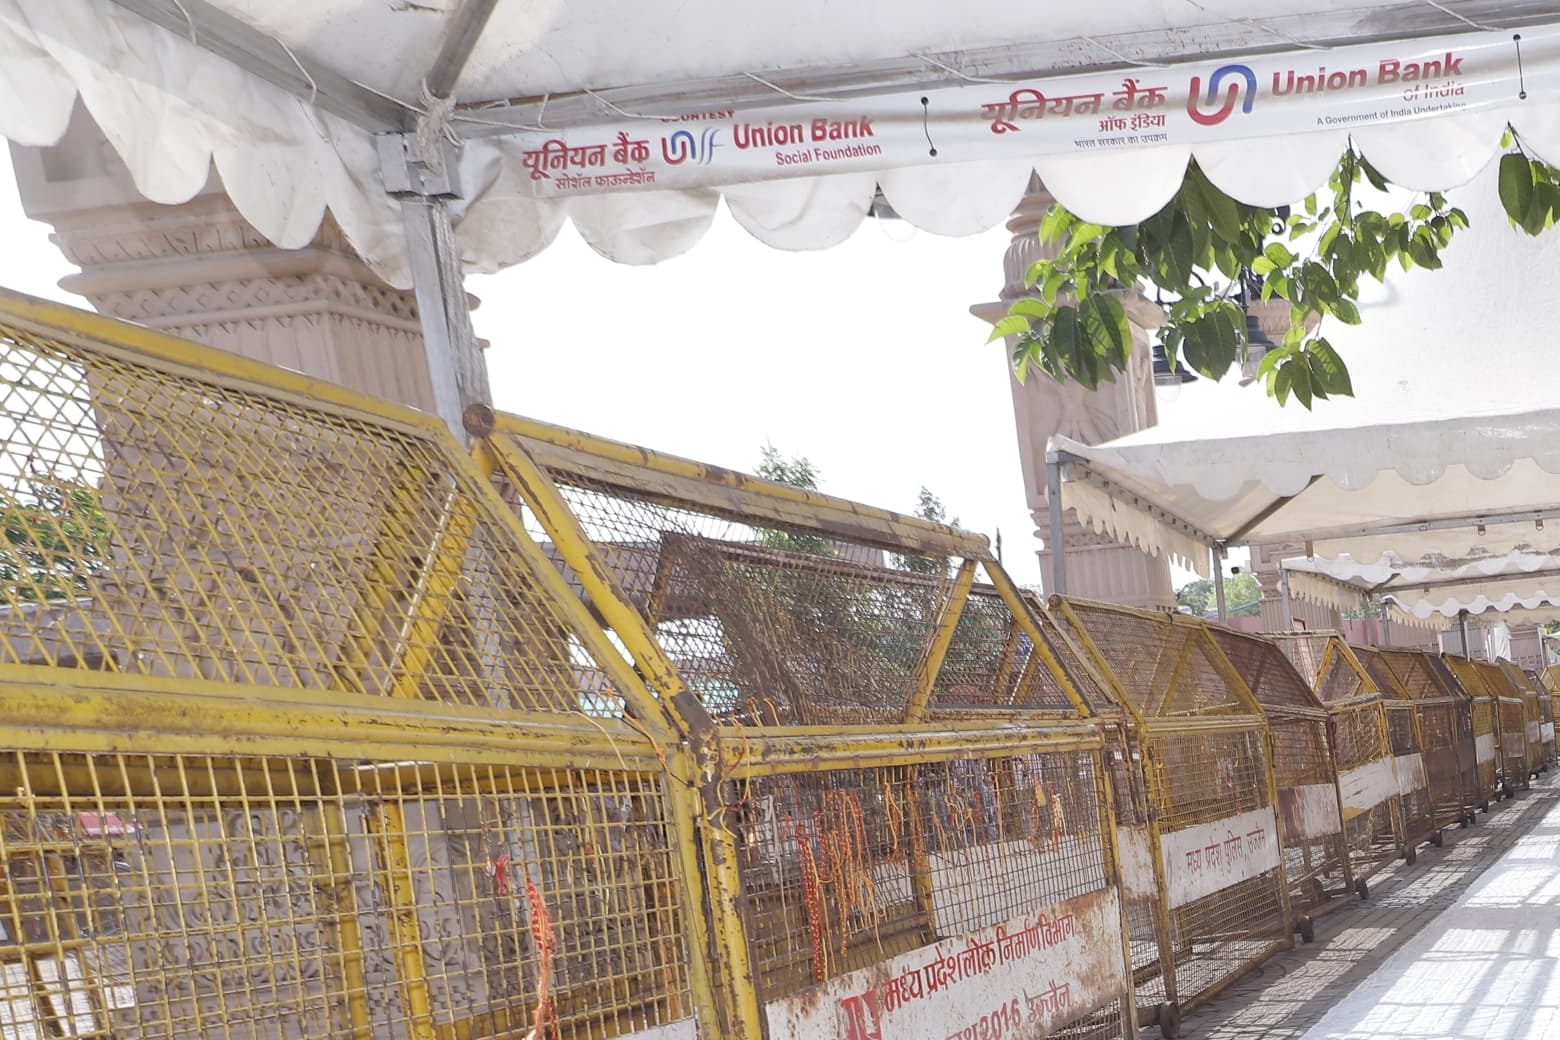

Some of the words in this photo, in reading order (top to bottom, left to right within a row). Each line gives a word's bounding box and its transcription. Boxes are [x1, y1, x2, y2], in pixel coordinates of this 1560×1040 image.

[1271, 66, 1368, 97] Union
[1378, 52, 1465, 84] Bank
[1403, 83, 1420, 101] of
[1424, 80, 1464, 99] India
[979, 88, 1104, 134] यूनियन
[1112, 78, 1168, 111] बैंक
[1317, 117, 1324, 126] A
[1325, 111, 1378, 125] Government
[1380, 110, 1389, 118] of
[1390, 107, 1412, 118] India
[733, 120, 804, 149] Union
[811, 115, 875, 142] Bank
[1098, 114, 1127, 133] ऑफ
[1130, 113, 1166, 132] इंडिया
[522, 139, 607, 180] यूनियन
[612, 131, 650, 164] बैंक
[775, 150, 813, 166] Social
[815, 144, 882, 162] Foundation
[1074, 138, 1095, 149] भारत
[880, 969, 924, 1013] मध्य
